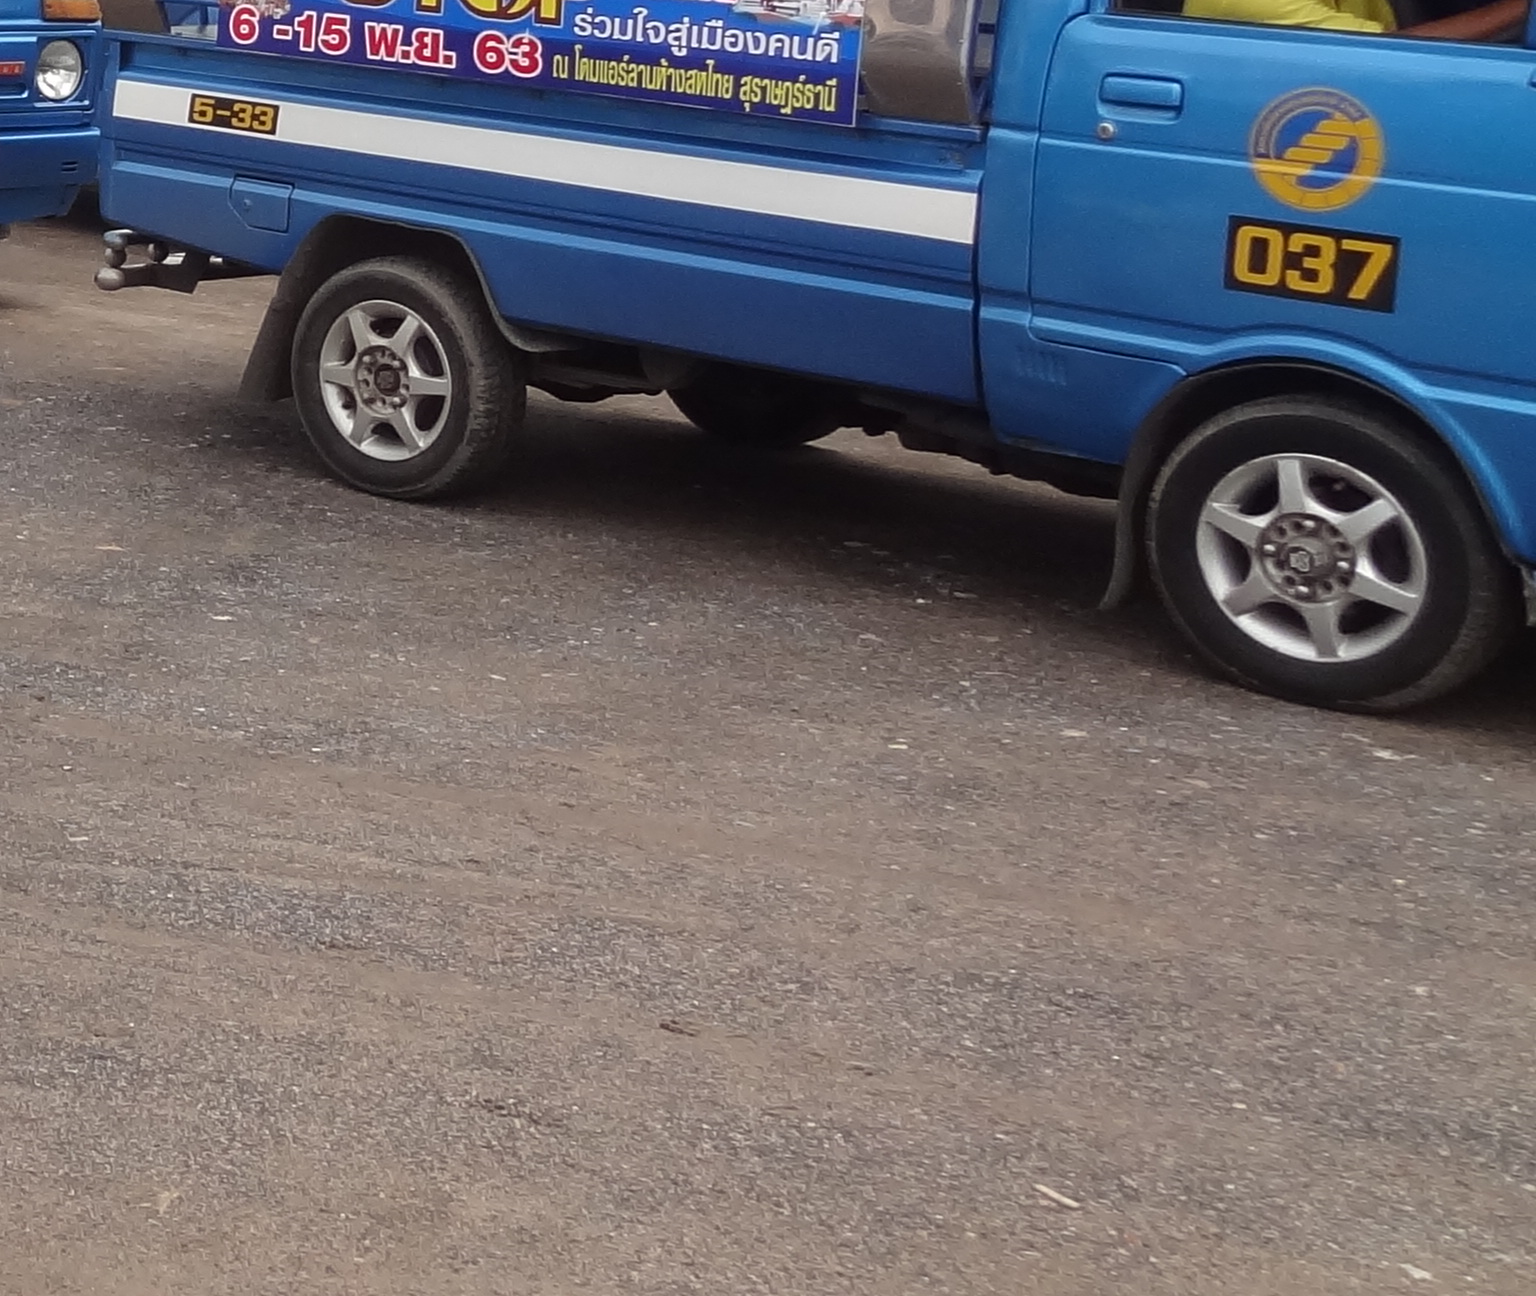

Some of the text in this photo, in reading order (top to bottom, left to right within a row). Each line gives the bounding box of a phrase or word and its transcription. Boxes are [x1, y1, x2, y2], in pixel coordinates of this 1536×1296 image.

[228, 4, 542, 78] 6 -15 พ.ย. 63
[573, 6, 840, 64] ร่วมใจสู่เมืองคนดี
[192, 96, 275, 132] 5-33
[552, 44, 838, 114] ณ โดมแอร์ลานห้างสหไทย สุราษฎร์ธานี
[1232, 224, 1393, 301] 037
